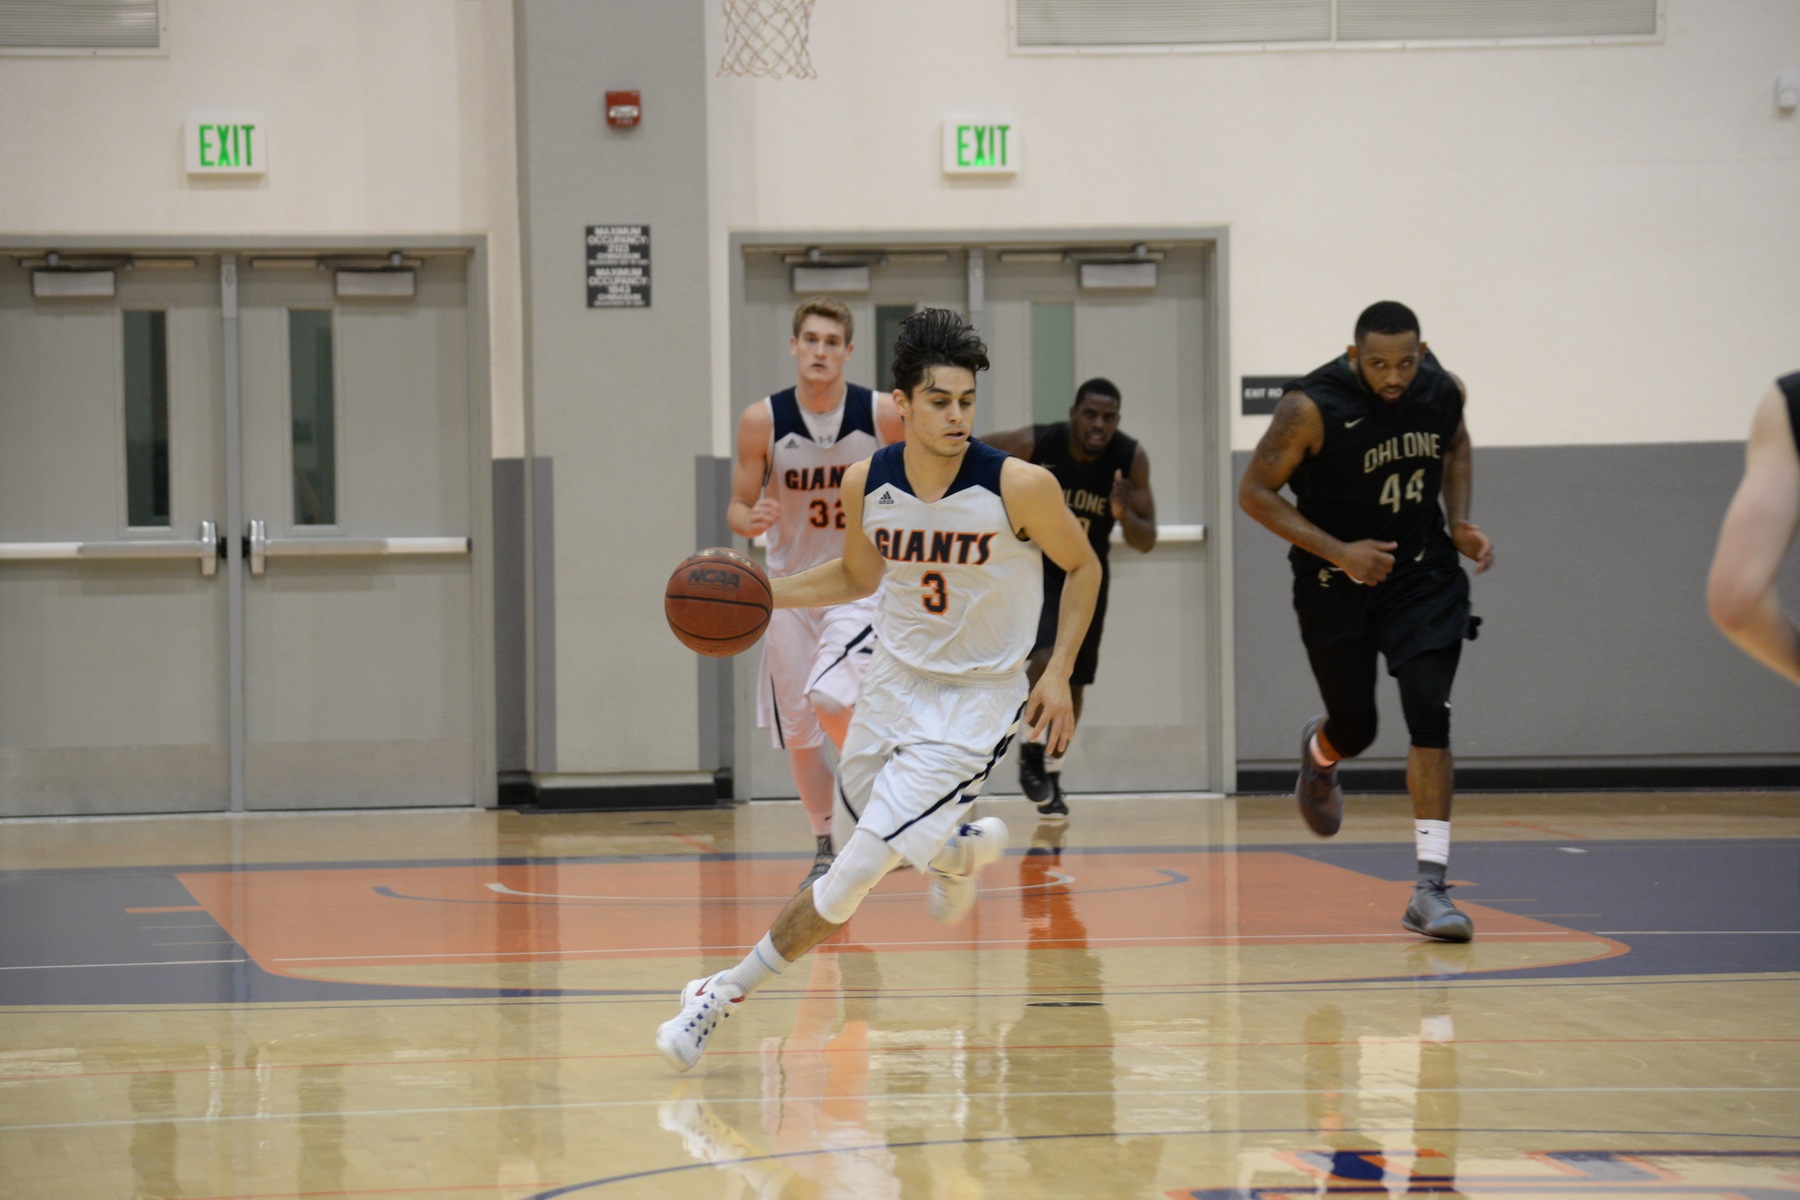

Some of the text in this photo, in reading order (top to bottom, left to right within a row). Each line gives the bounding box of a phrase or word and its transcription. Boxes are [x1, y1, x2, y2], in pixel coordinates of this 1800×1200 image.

[199, 124, 255, 167] EXIT
[957, 124, 1010, 167] EXIT
[594, 226, 642, 235] MAXIMUM
[595, 267, 642, 276] MAXIMUM
[1244, 387, 1284, 399] EXIT RO
[1363, 431, 1441, 474] OHLONE
[784, 464, 851, 491] GIAN
[1379, 468, 1426, 514] 44
[809, 499, 847, 531] 32
[1063, 487, 1108, 517] LONE
[874, 527, 999, 566] GIANTS
[687, 568, 741, 589] NCAA
[921, 570, 949, 616] 3
